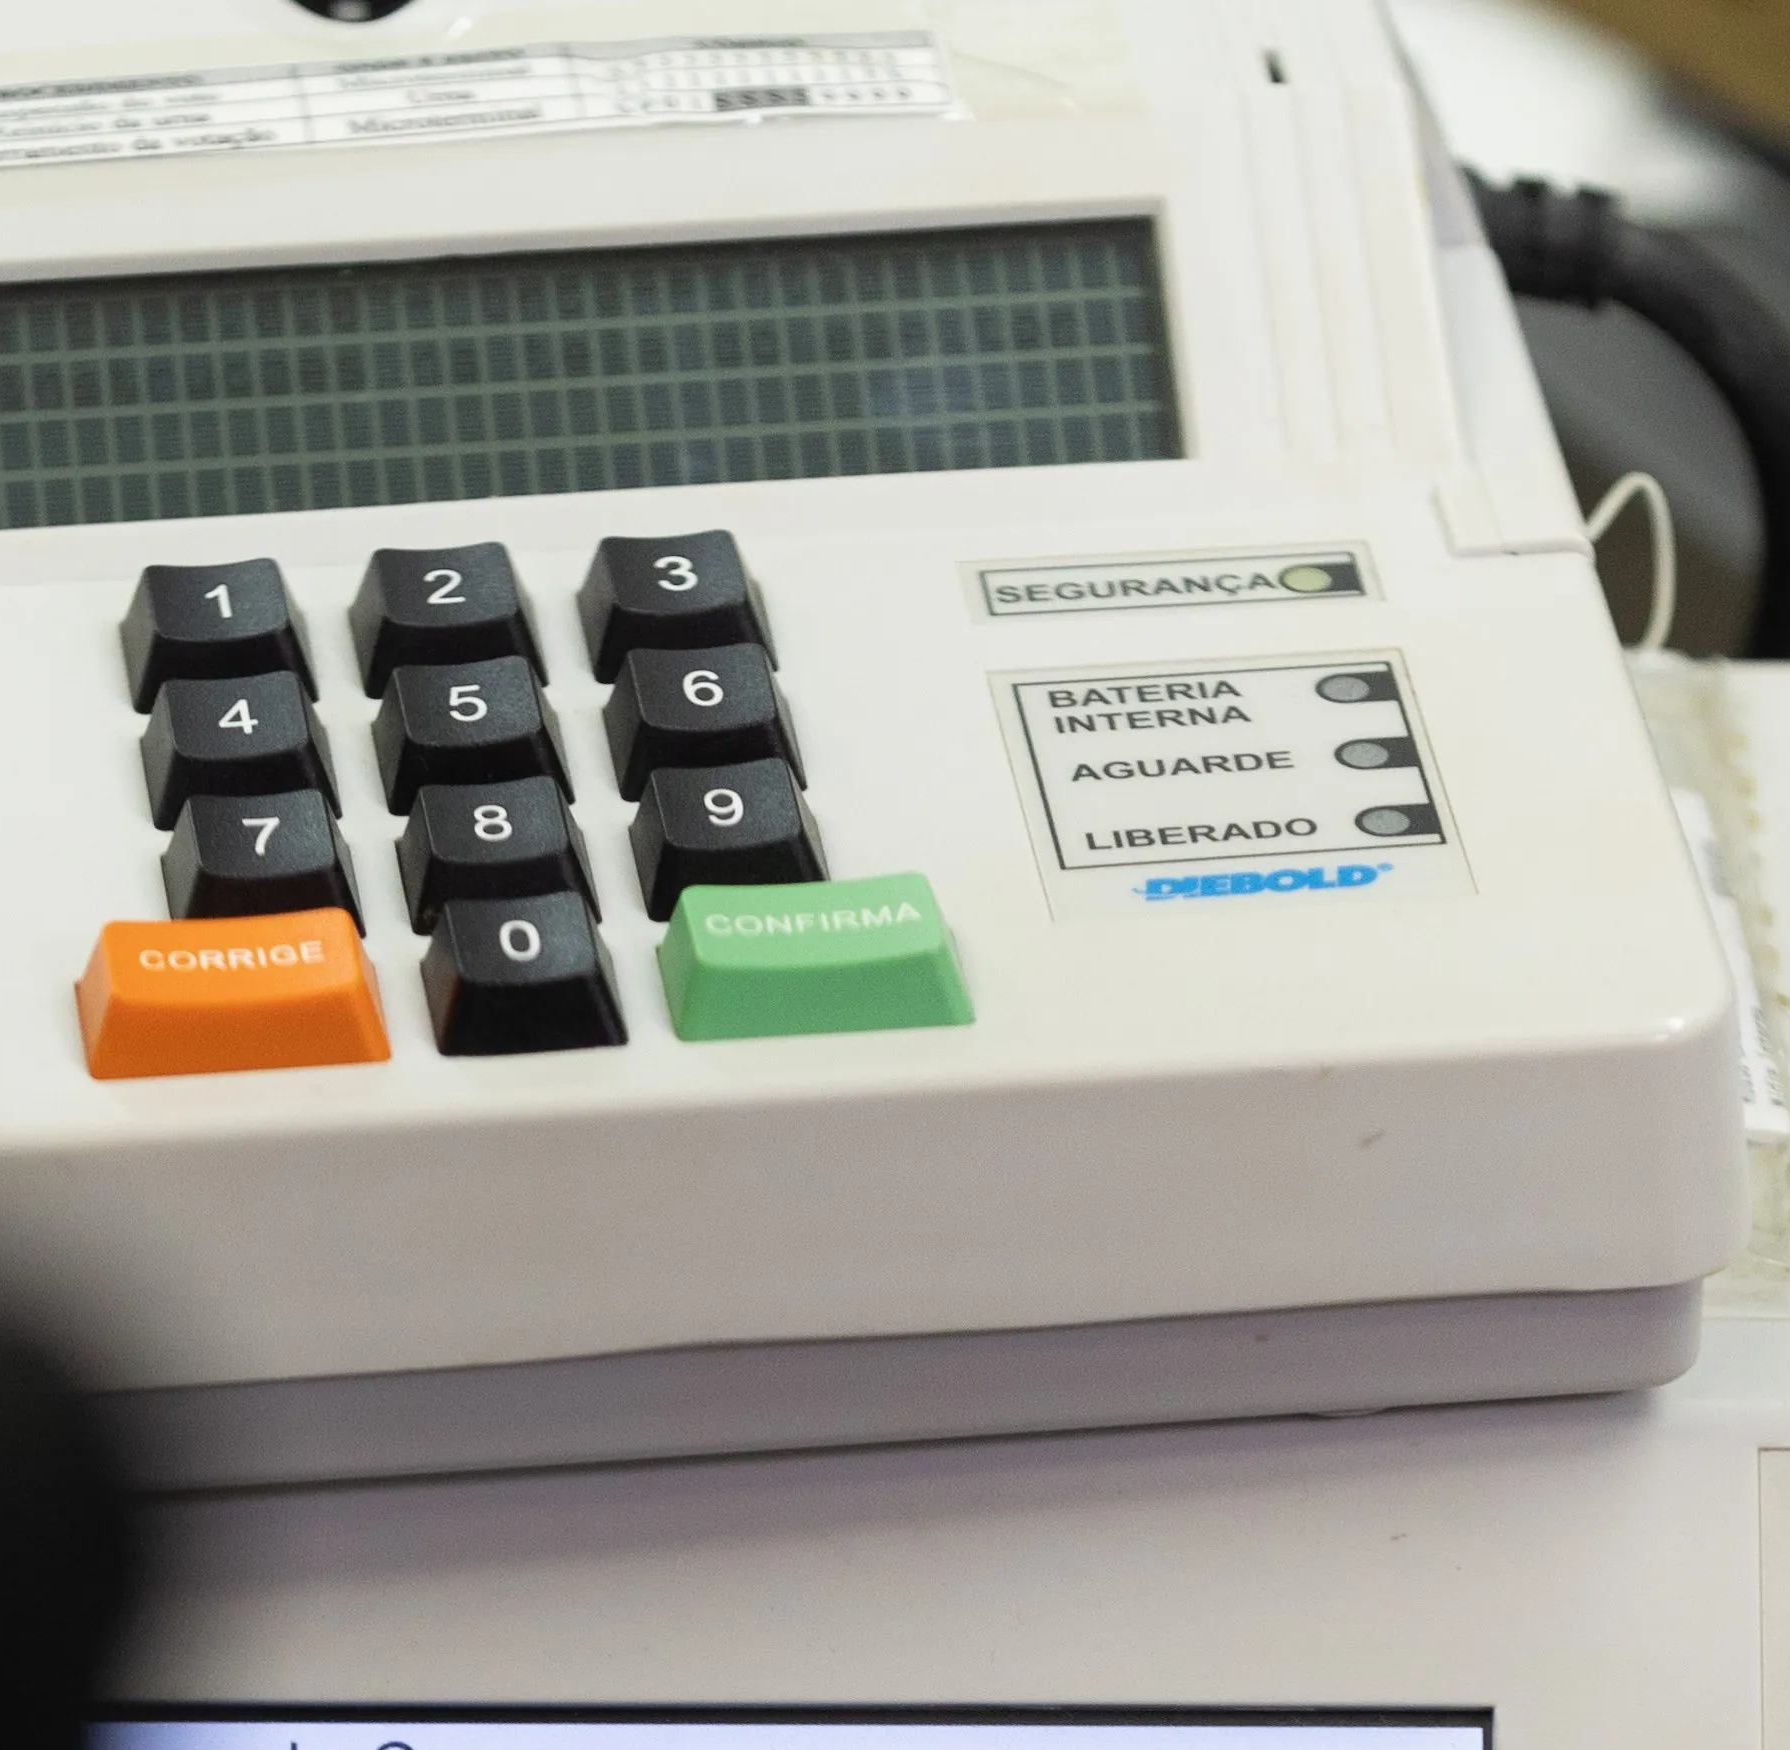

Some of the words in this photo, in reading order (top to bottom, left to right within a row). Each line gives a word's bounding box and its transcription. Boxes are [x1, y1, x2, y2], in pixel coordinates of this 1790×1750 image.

[424, 570, 466, 604] 2
[655, 556, 698, 591] 3
[996, 573, 1277, 604] SEGURANÇA
[205, 585, 232, 618] 1
[450, 685, 487, 721] 5
[683, 670, 723, 706] 6
[1046, 679, 1242, 709] BATERIA
[219, 699, 258, 734] 4
[1053, 705, 1251, 734] INTERNA
[1072, 751, 1294, 782] AGUARDE
[474, 805, 512, 841] 8
[704, 789, 743, 826] 9
[242, 817, 280, 855] 7
[1086, 818, 1319, 851] LIBERADO
[1143, 865, 1382, 900] DIEBOLD
[706, 901, 922, 934] CONFIRMA
[140, 940, 324, 969] CORRIGE
[500, 920, 541, 961] 0
